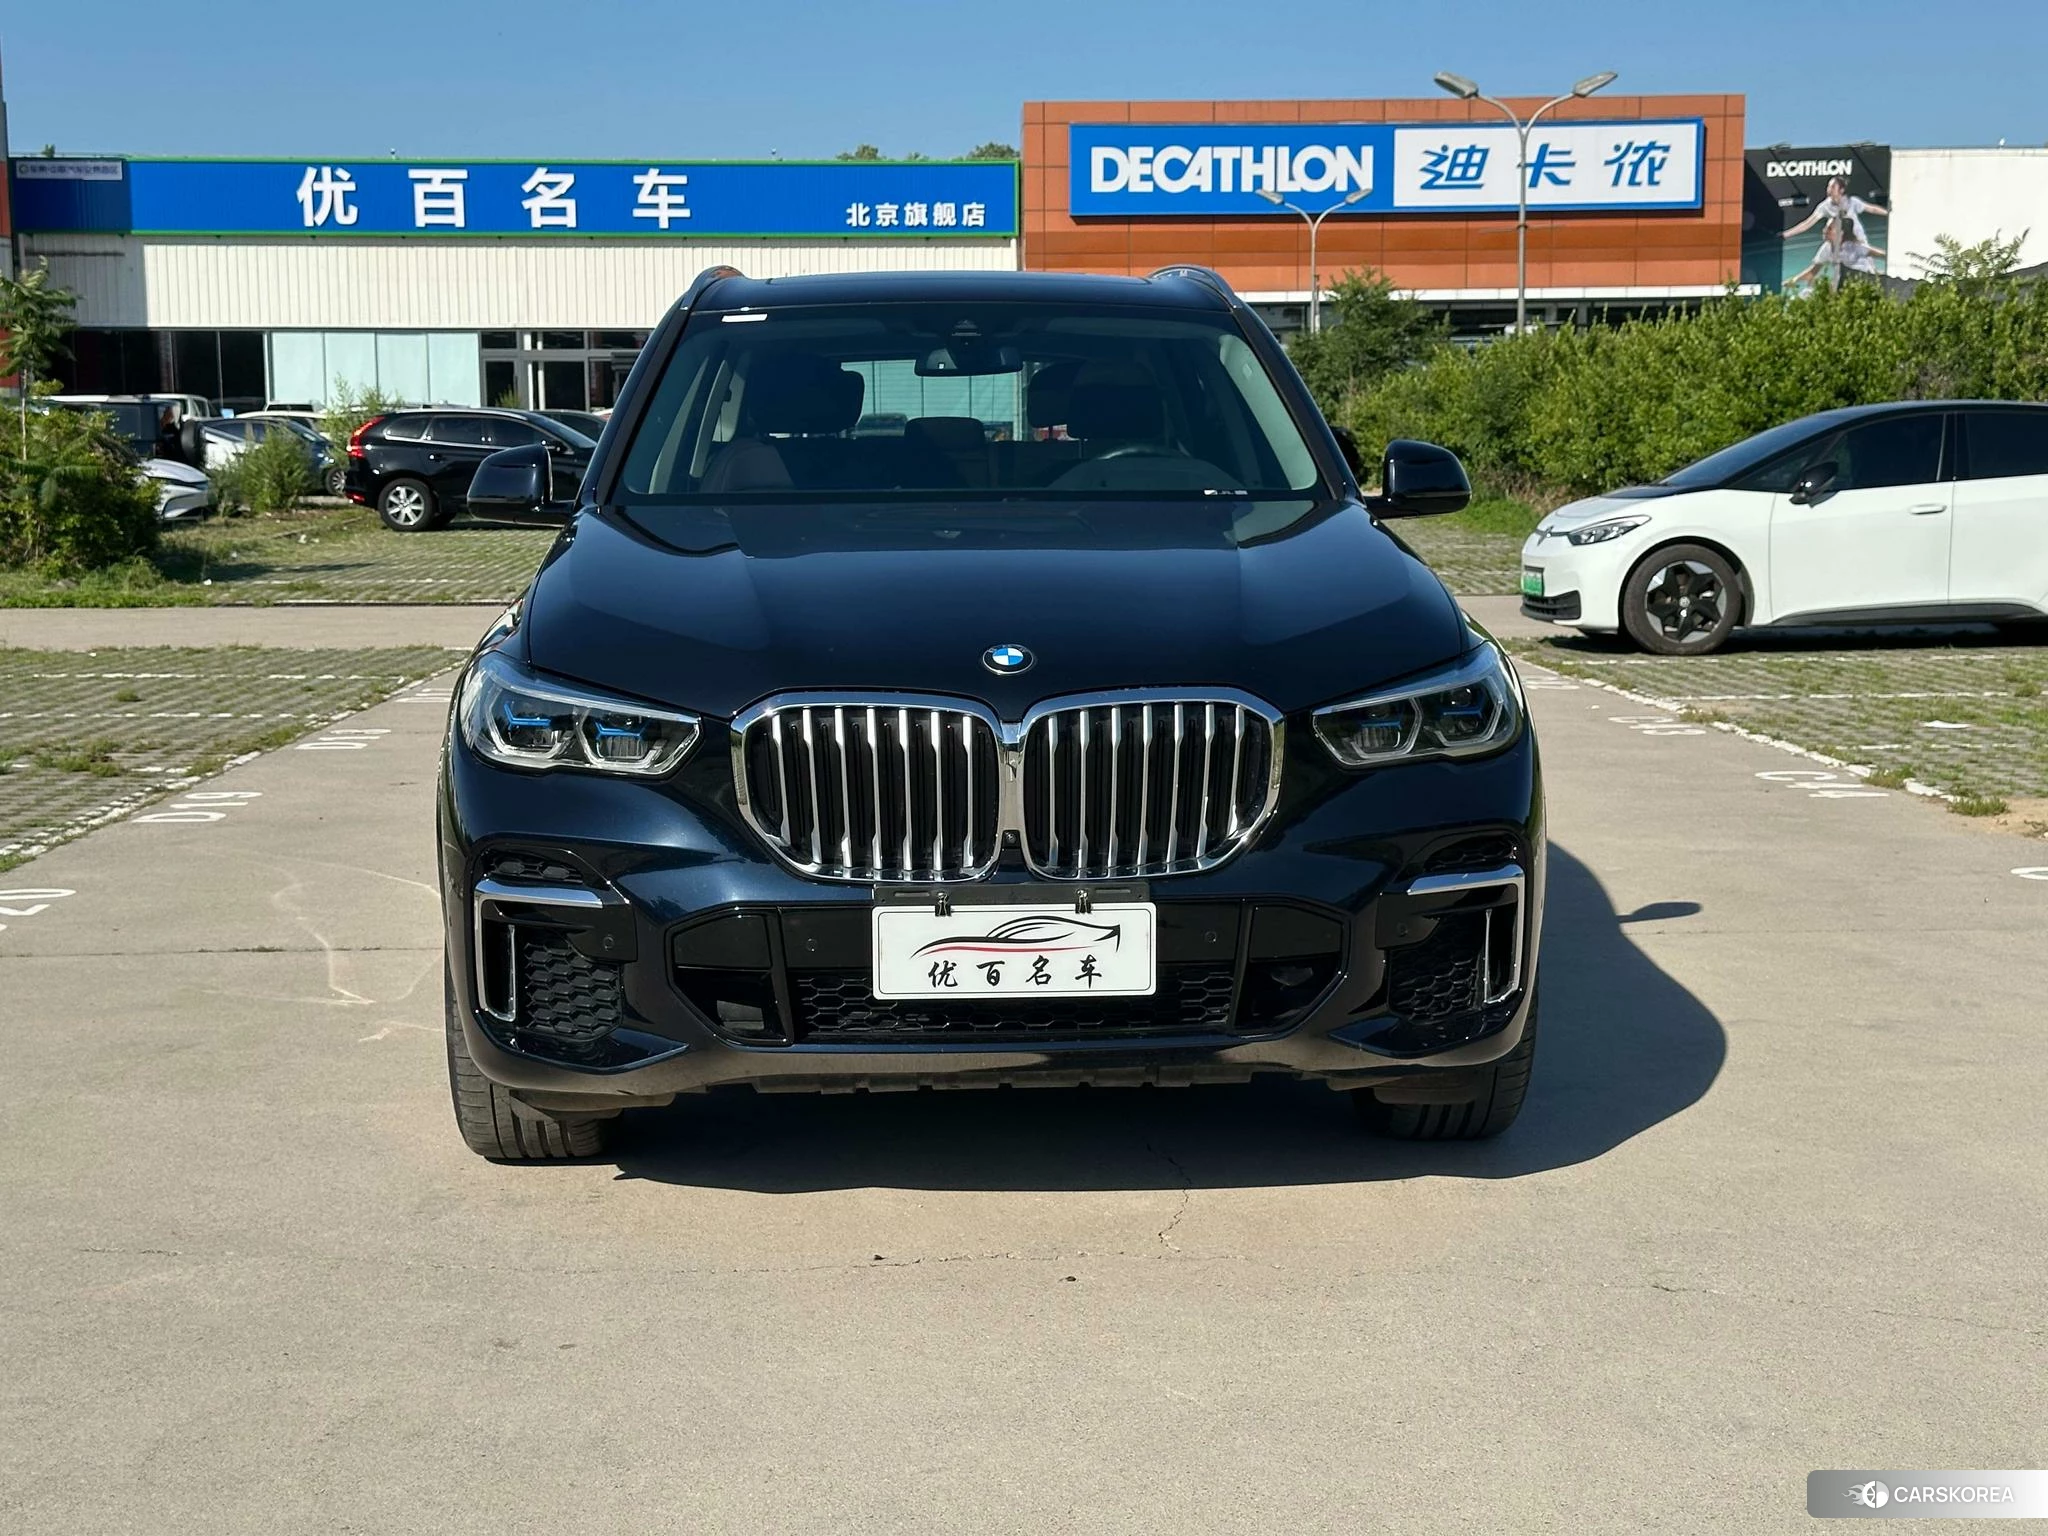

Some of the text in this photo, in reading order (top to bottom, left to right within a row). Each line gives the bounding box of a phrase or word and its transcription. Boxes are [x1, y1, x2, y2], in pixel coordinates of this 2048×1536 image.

[1091, 145, 1374, 194] DECATHLON
[1418, 141, 1671, 189] 迪卡侬
[1766, 160, 1853, 177] DECATHLON
[297, 166, 691, 229] 优百名车
[846, 203, 985, 227] 北京旗舰店
[131, 791, 263, 823] D19
[927, 954, 1103, 989] 优百名车
